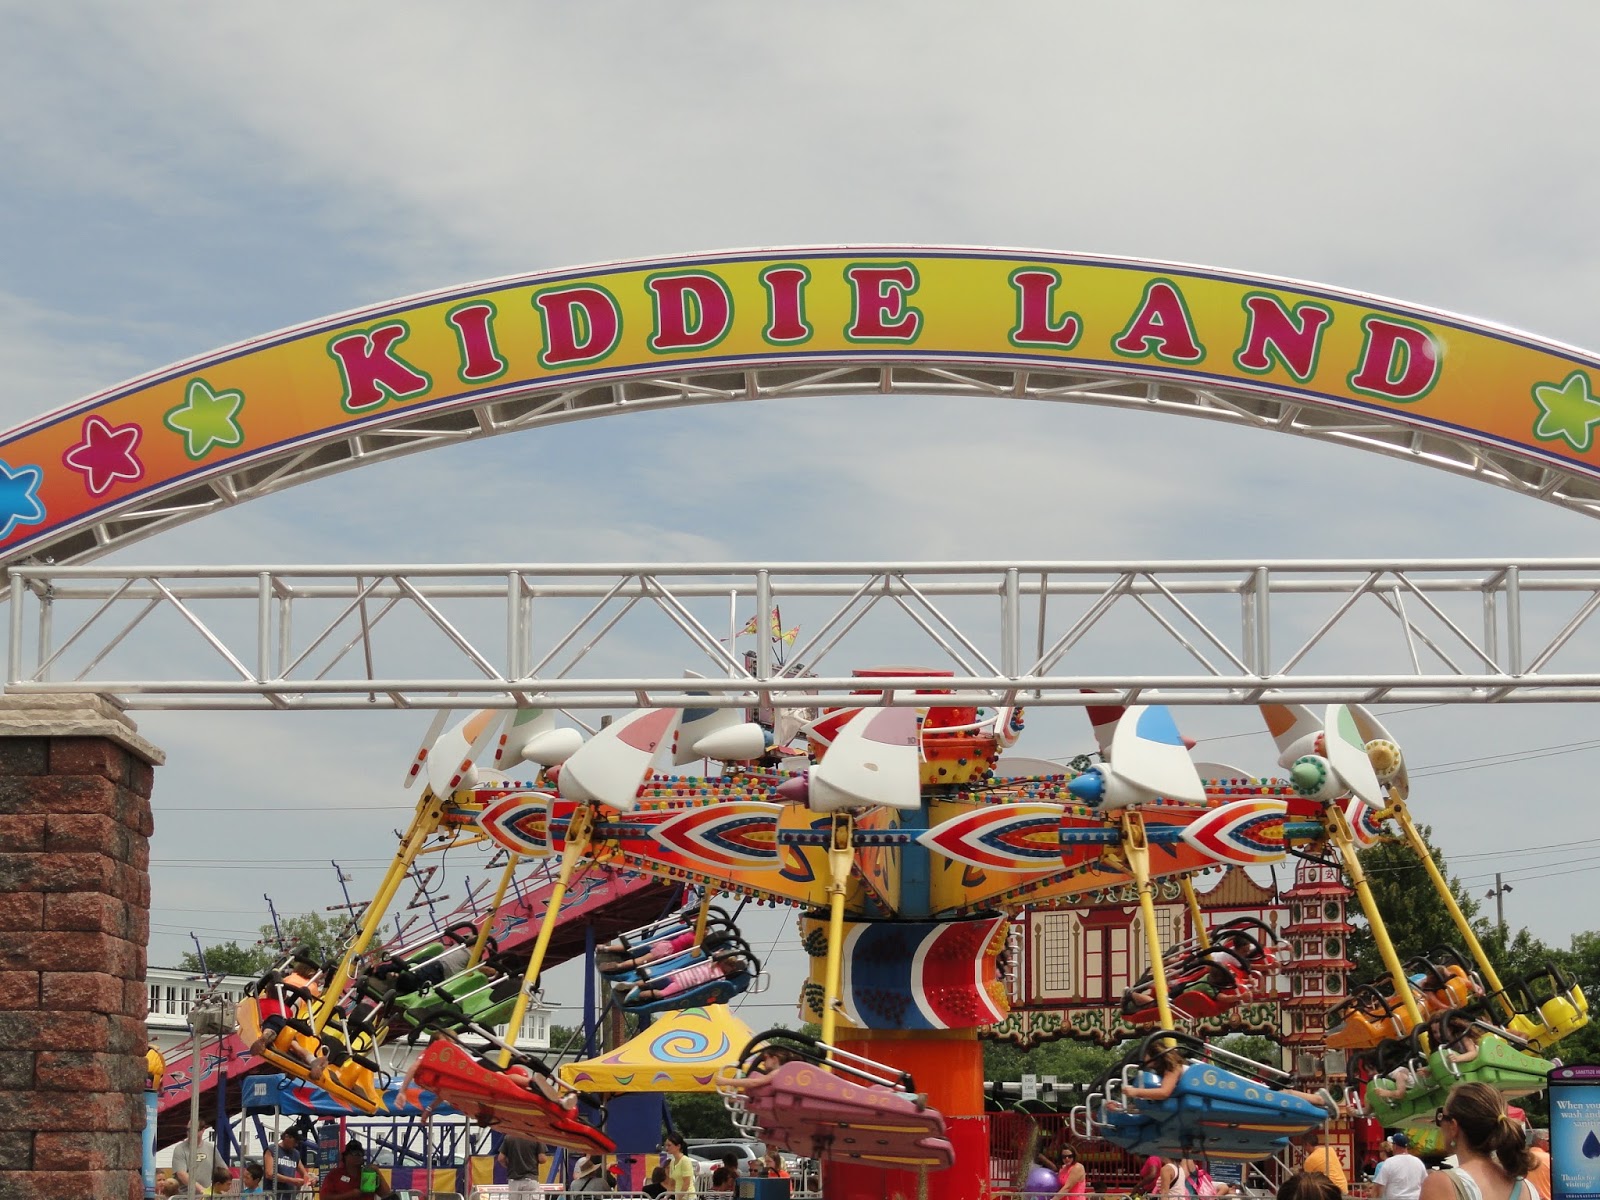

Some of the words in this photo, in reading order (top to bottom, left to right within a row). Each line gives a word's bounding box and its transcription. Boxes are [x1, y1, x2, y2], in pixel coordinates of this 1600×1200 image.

[328, 263, 922, 411] KIDDIE
[1009, 267, 1441, 401] LAND
[907, 736, 916, 744] 10
[1556, 1101, 1583, 1109] When
[1561, 1110, 1582, 1118] wash
[196, 1153, 207, 1162] P
[1565, 1181, 1592, 1189] visiting!
